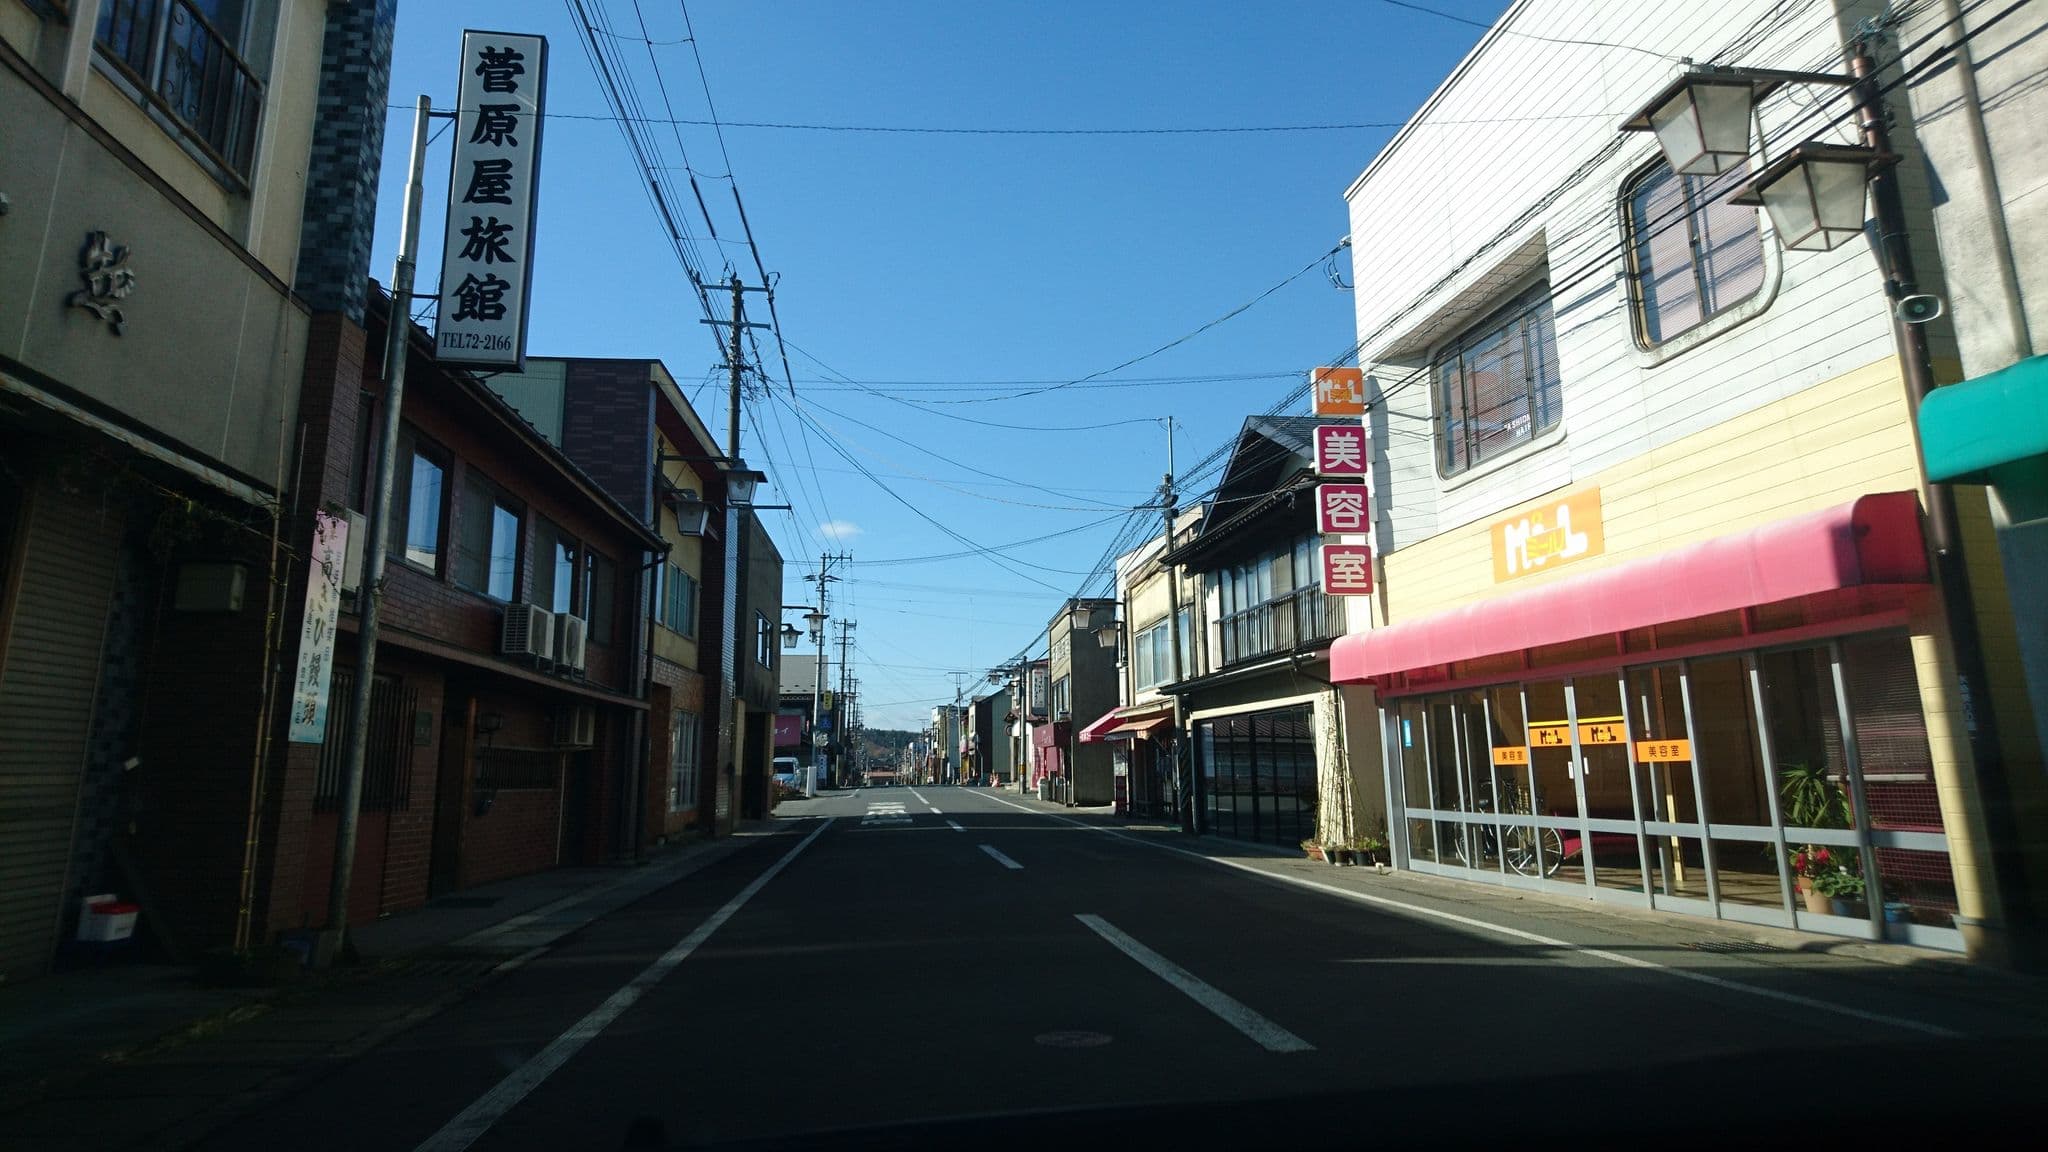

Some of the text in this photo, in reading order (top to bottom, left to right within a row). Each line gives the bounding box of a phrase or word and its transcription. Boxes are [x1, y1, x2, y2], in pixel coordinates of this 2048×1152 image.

[451, 46, 524, 323] 菅原屋旅館
[441, 332, 511, 351] TEL72-2166
[1324, 431, 1367, 588] 美容室
[1526, 526, 1567, 559] ミール
[1648, 744, 1680, 758] 美容室
